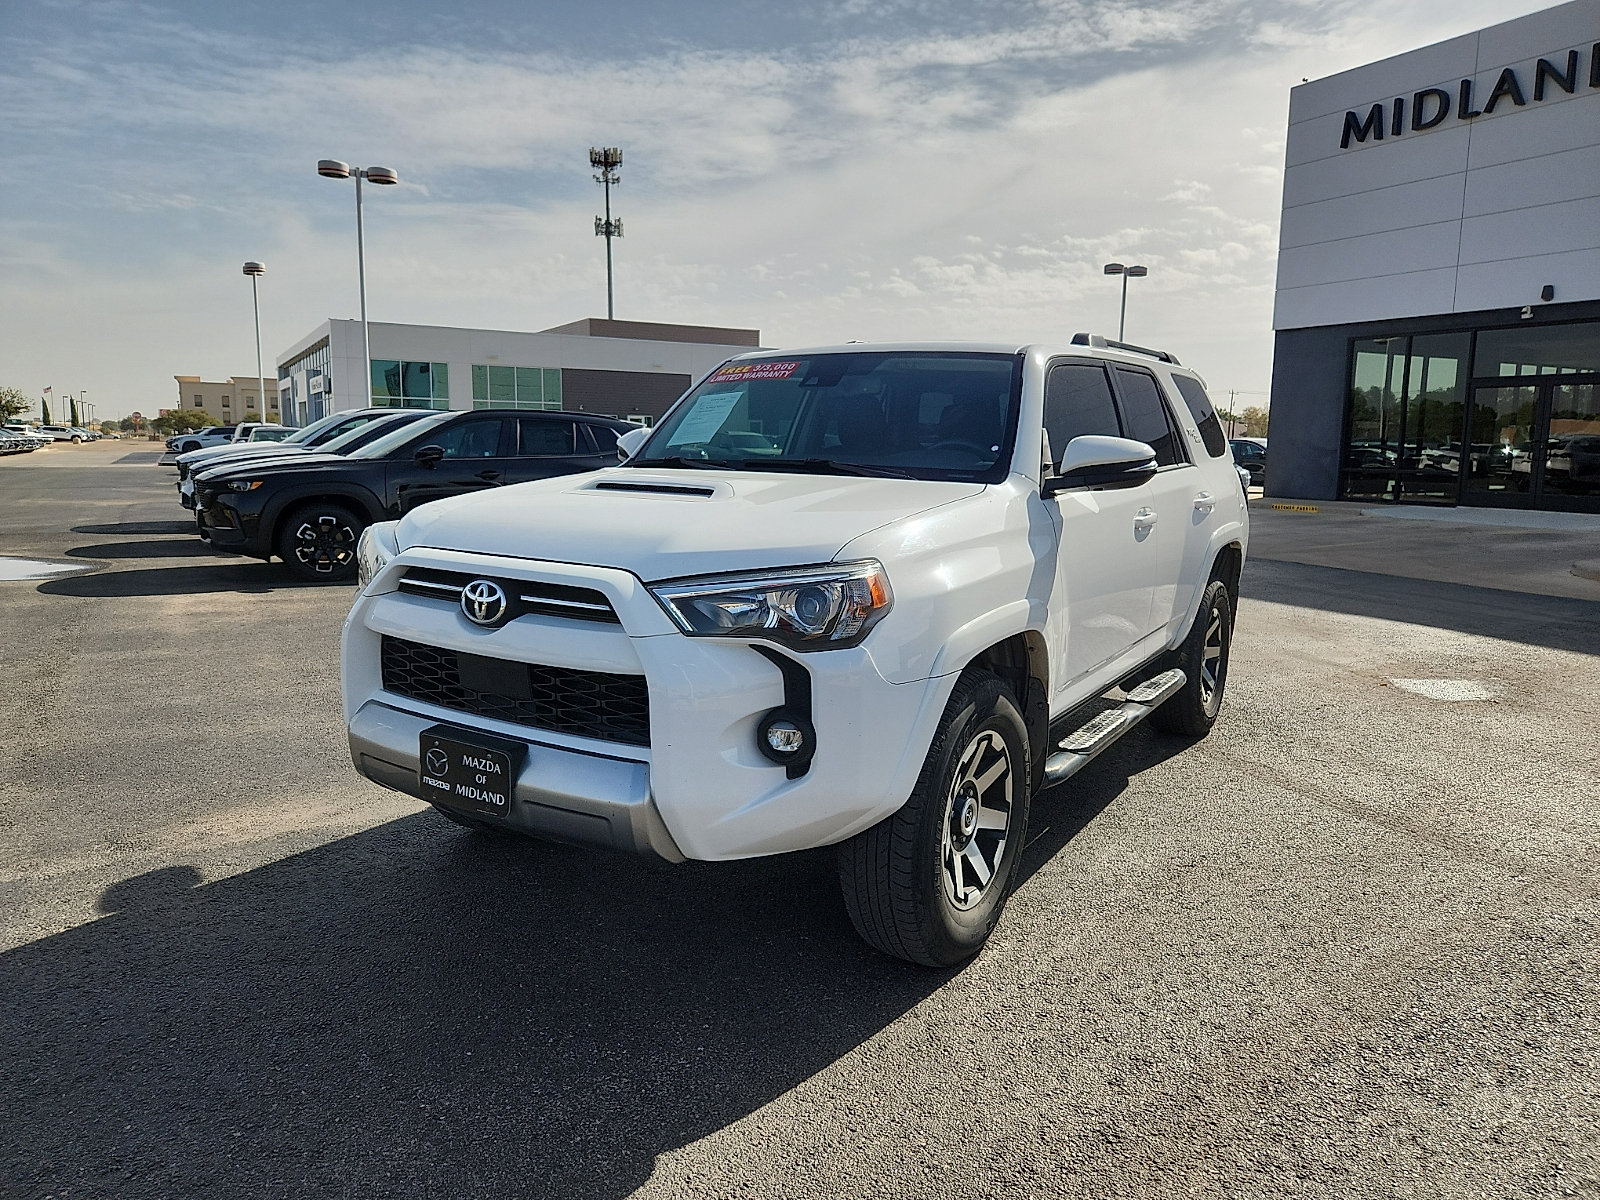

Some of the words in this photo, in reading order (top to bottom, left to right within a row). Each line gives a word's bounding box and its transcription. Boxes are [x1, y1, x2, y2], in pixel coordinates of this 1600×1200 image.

[719, 365, 752, 374] FREE
[753, 363, 796, 372] 3/3,000
[709, 373, 742, 383] LIMITED
[742, 371, 793, 380] WARRANTY
[462, 755, 501, 774] MAZDA
[423, 776, 450, 790] mazda
[475, 774, 487, 784] OF
[455, 784, 505, 805] MIDLAND
